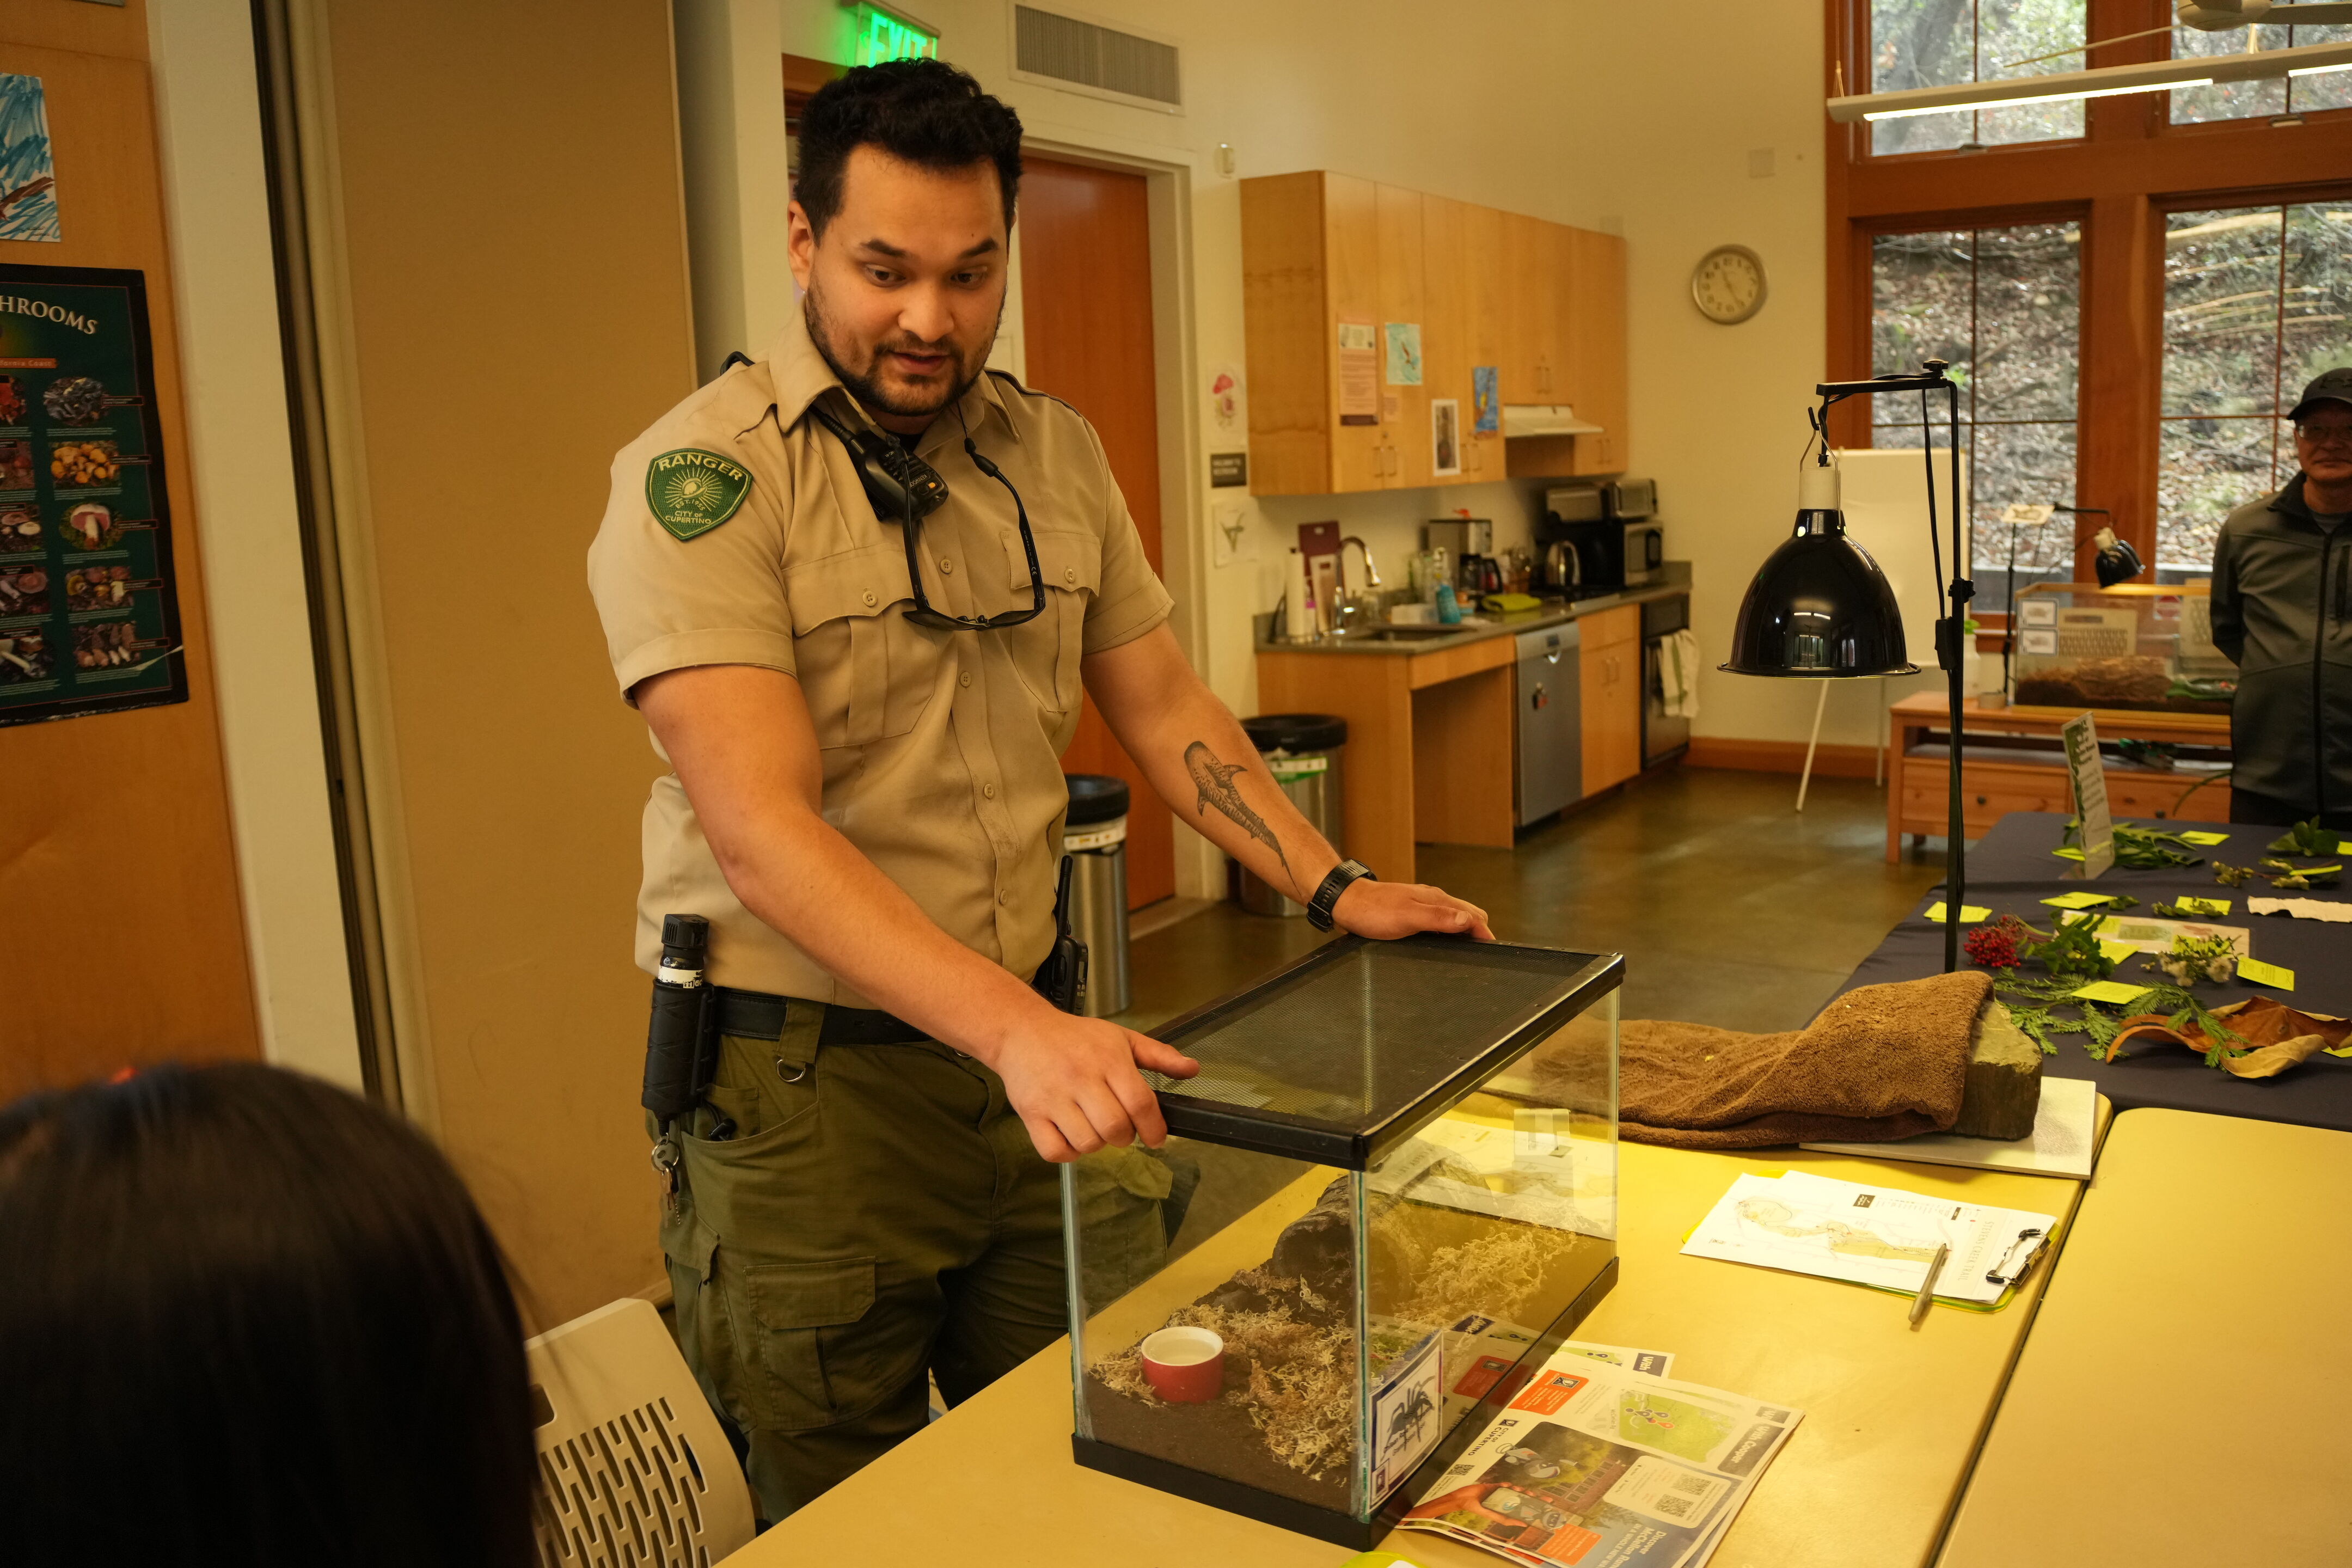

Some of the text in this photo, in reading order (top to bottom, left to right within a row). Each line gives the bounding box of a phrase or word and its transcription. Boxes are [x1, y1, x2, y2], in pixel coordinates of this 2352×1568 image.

[658, 454, 743, 481] RANGER
[675, 499, 706, 511] EST. 1955
[665, 516, 711, 525] CUPERTINO
[1958, 1221, 1994, 1281] STEVENS CREEK TRAIL
[1639, 1356, 1653, 1371] With
[1468, 1426, 1502, 1456] CUPERTINO
[1497, 1428, 1509, 1437] CITY
[1731, 1425, 1769, 1464] With Cooper
[1615, 1533, 1633, 1549] WHOLE
[1623, 1527, 1655, 1555] McClellan
[1639, 1531, 1667, 1555] Discover
[1605, 1548, 1618, 1560] NEW
